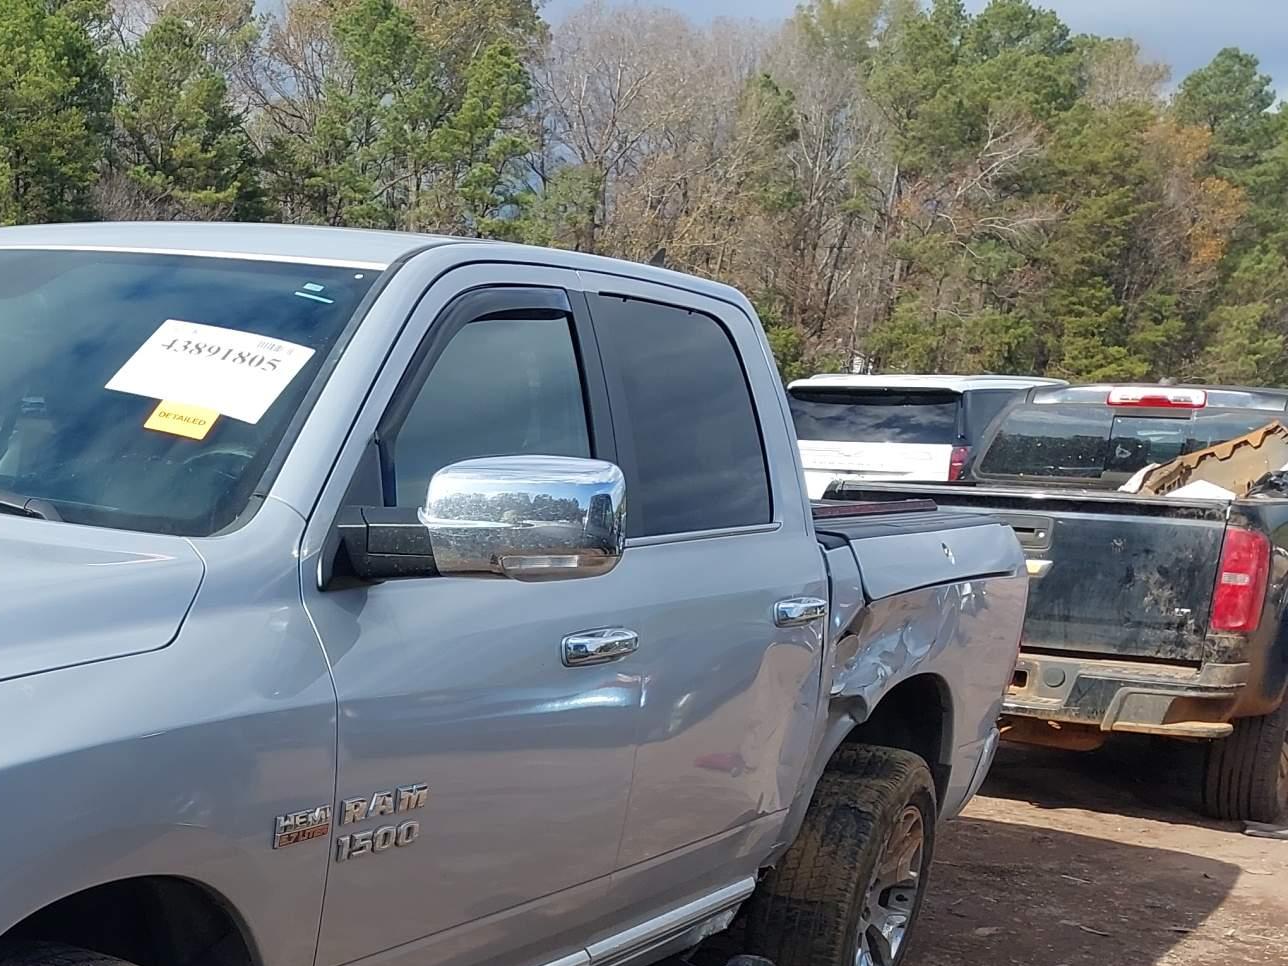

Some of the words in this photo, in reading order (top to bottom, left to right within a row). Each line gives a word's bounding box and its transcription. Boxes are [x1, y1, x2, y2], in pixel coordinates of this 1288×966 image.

[161, 338, 282, 372] 43891805
[158, 410, 207, 426] DETAILED
[276, 805, 332, 832] HEMI
[340, 783, 429, 826] RAM
[336, 820, 420, 863] 1500
